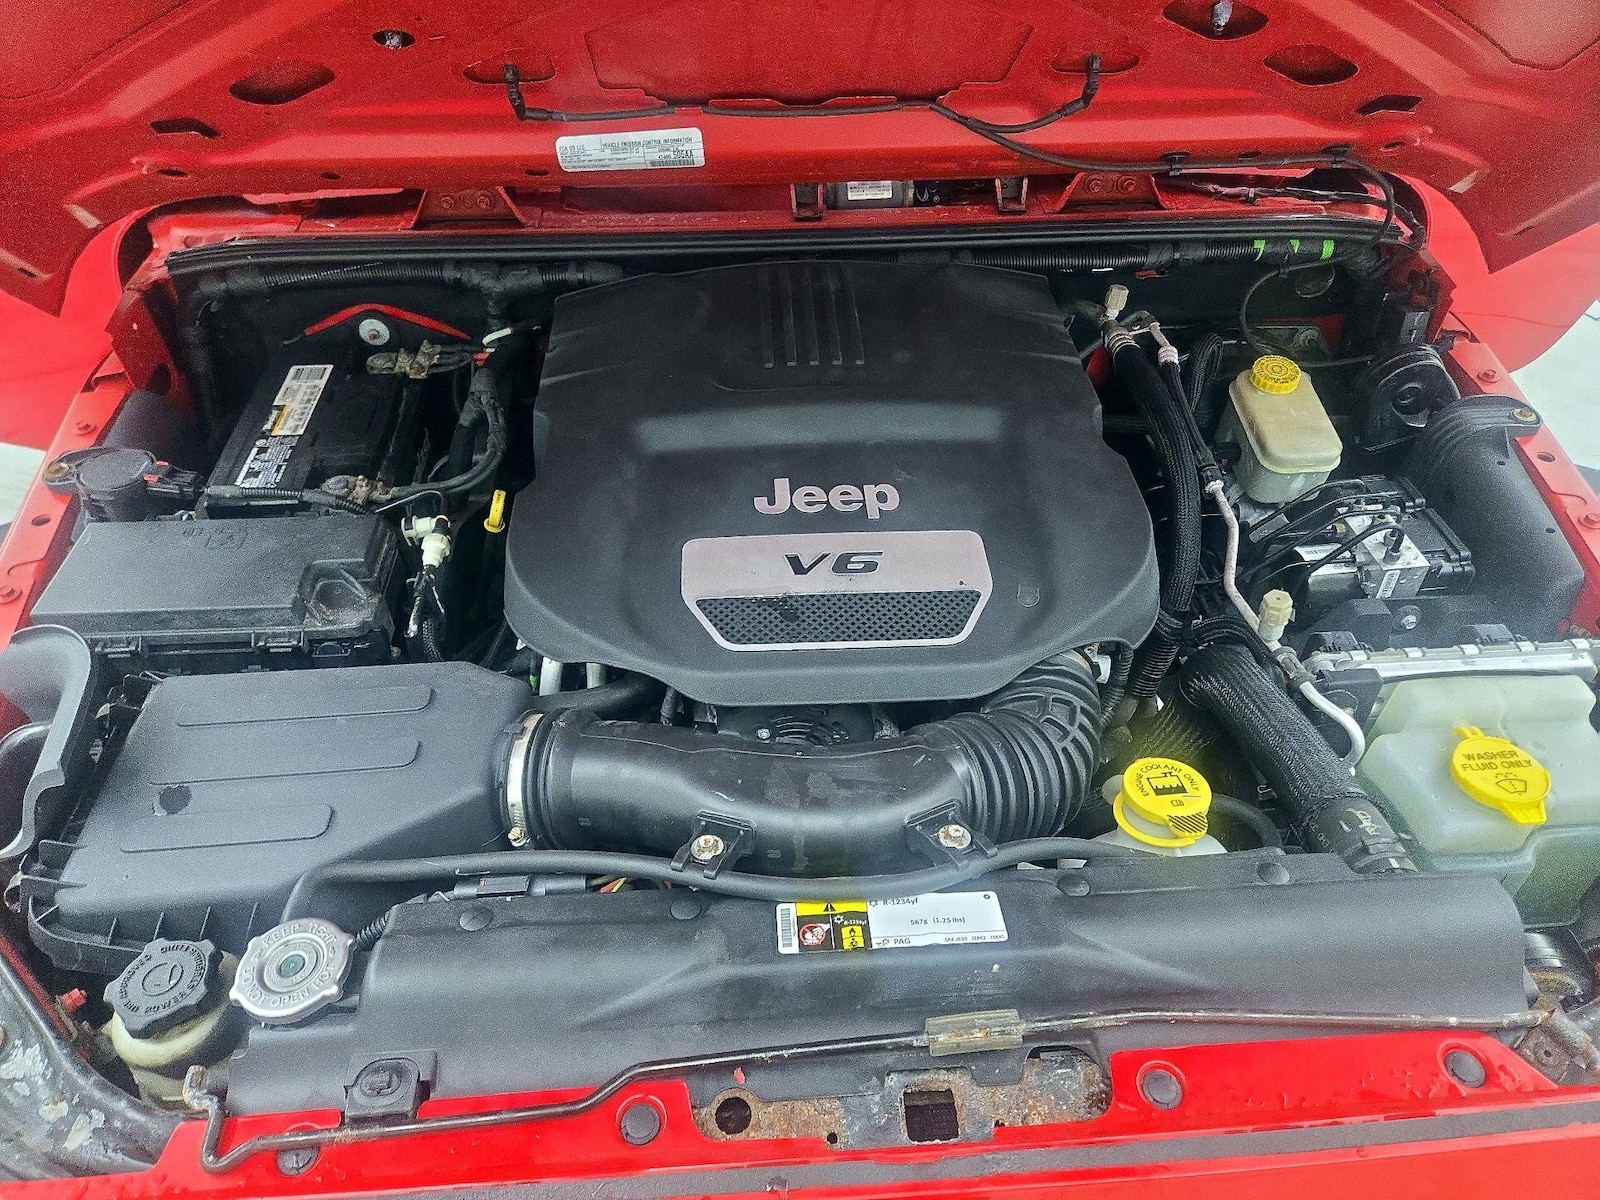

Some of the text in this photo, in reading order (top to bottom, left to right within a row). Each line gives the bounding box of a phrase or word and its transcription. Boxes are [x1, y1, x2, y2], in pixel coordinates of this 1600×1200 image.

[753, 477, 900, 519] Jeep
[784, 551, 884, 576] V6
[1462, 750, 1519, 762] WASHER
[1461, 759, 1532, 772] FLUID ONLY
[1135, 763, 1201, 797] ENGINE COOLANT ONLY
[882, 897, 919, 906] R-1234yf
[910, 918, 929, 926] 567g
[263, 922, 338, 948] KEEP TIGHT
[893, 937, 912, 945] PAG
[271, 988, 311, 1007] OPEN
